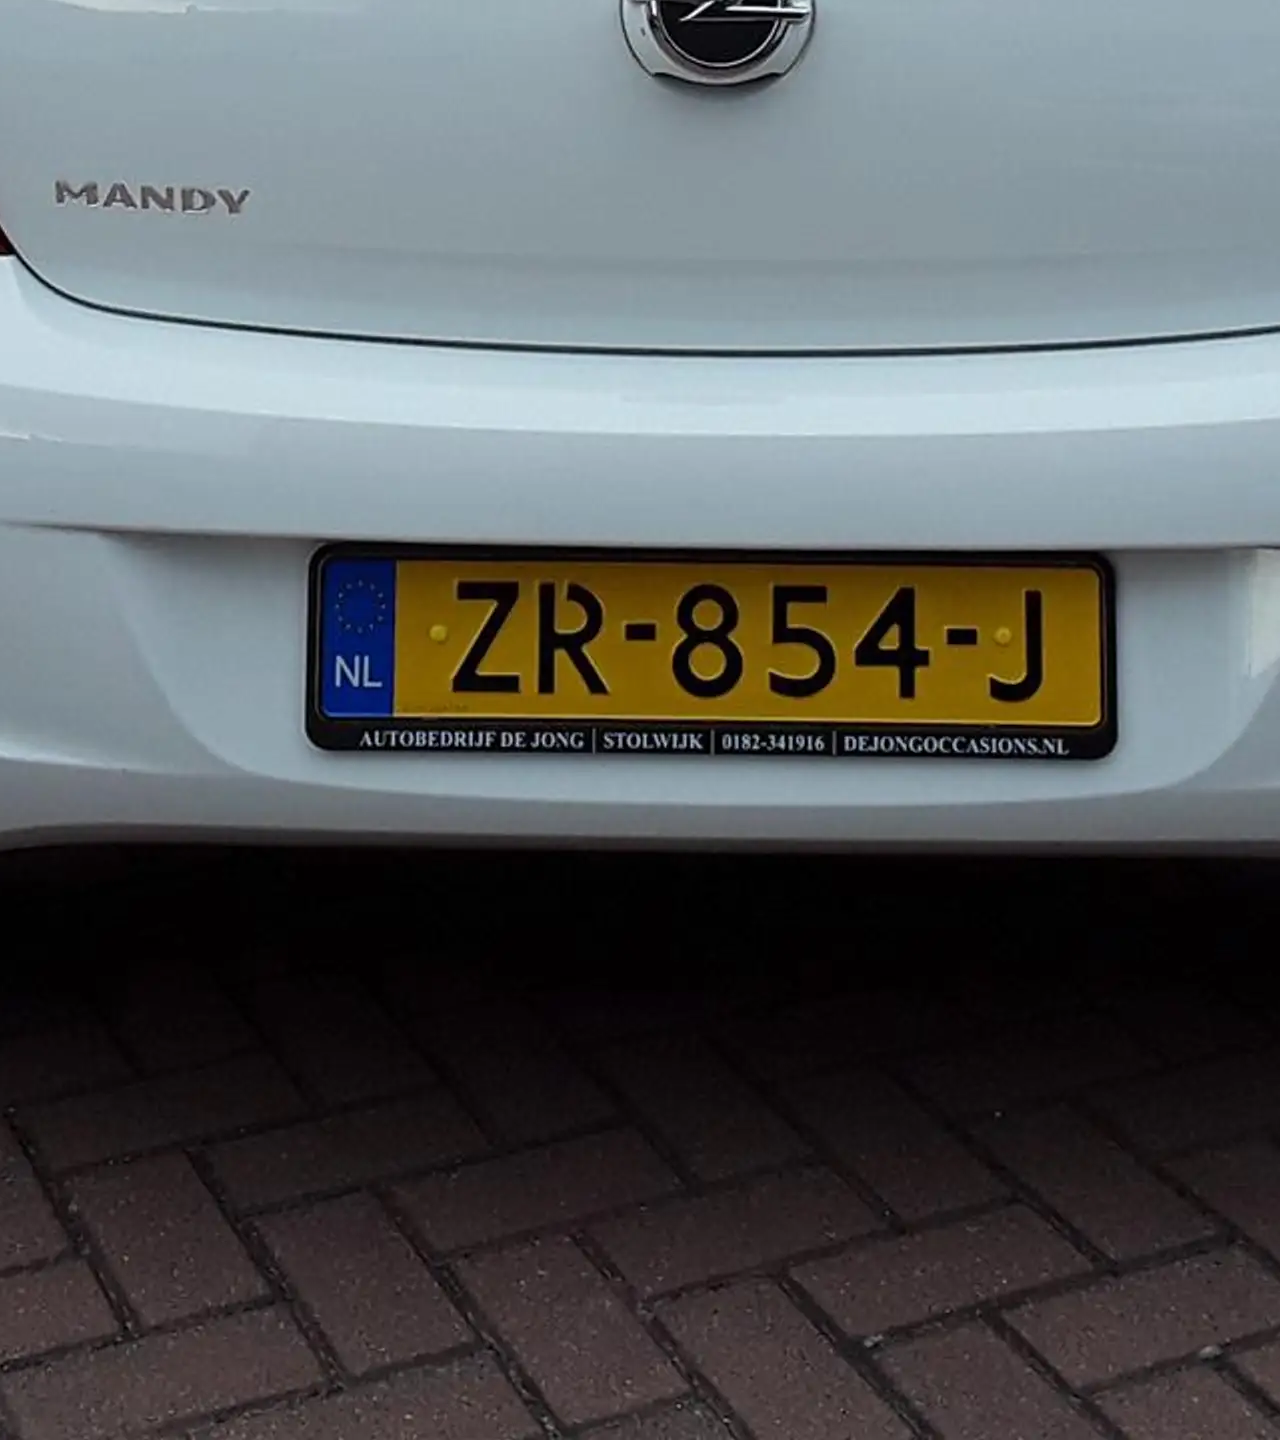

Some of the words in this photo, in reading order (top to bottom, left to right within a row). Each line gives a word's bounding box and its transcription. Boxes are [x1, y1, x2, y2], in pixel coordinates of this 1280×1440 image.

[55, 180, 251, 215] MANDY
[450, 579, 1044, 704] ZR-854-J
[334, 654, 383, 689] NL
[359, 730, 496, 748] AUTOBEDRIJF
[501, 731, 526, 748] DE
[530, 732, 584, 749] JONG
[603, 732, 703, 751] STOLWIJK
[721, 733, 826, 752] 0182-341916
[843, 735, 1070, 756] DEJONGOCCASIONS.NL
